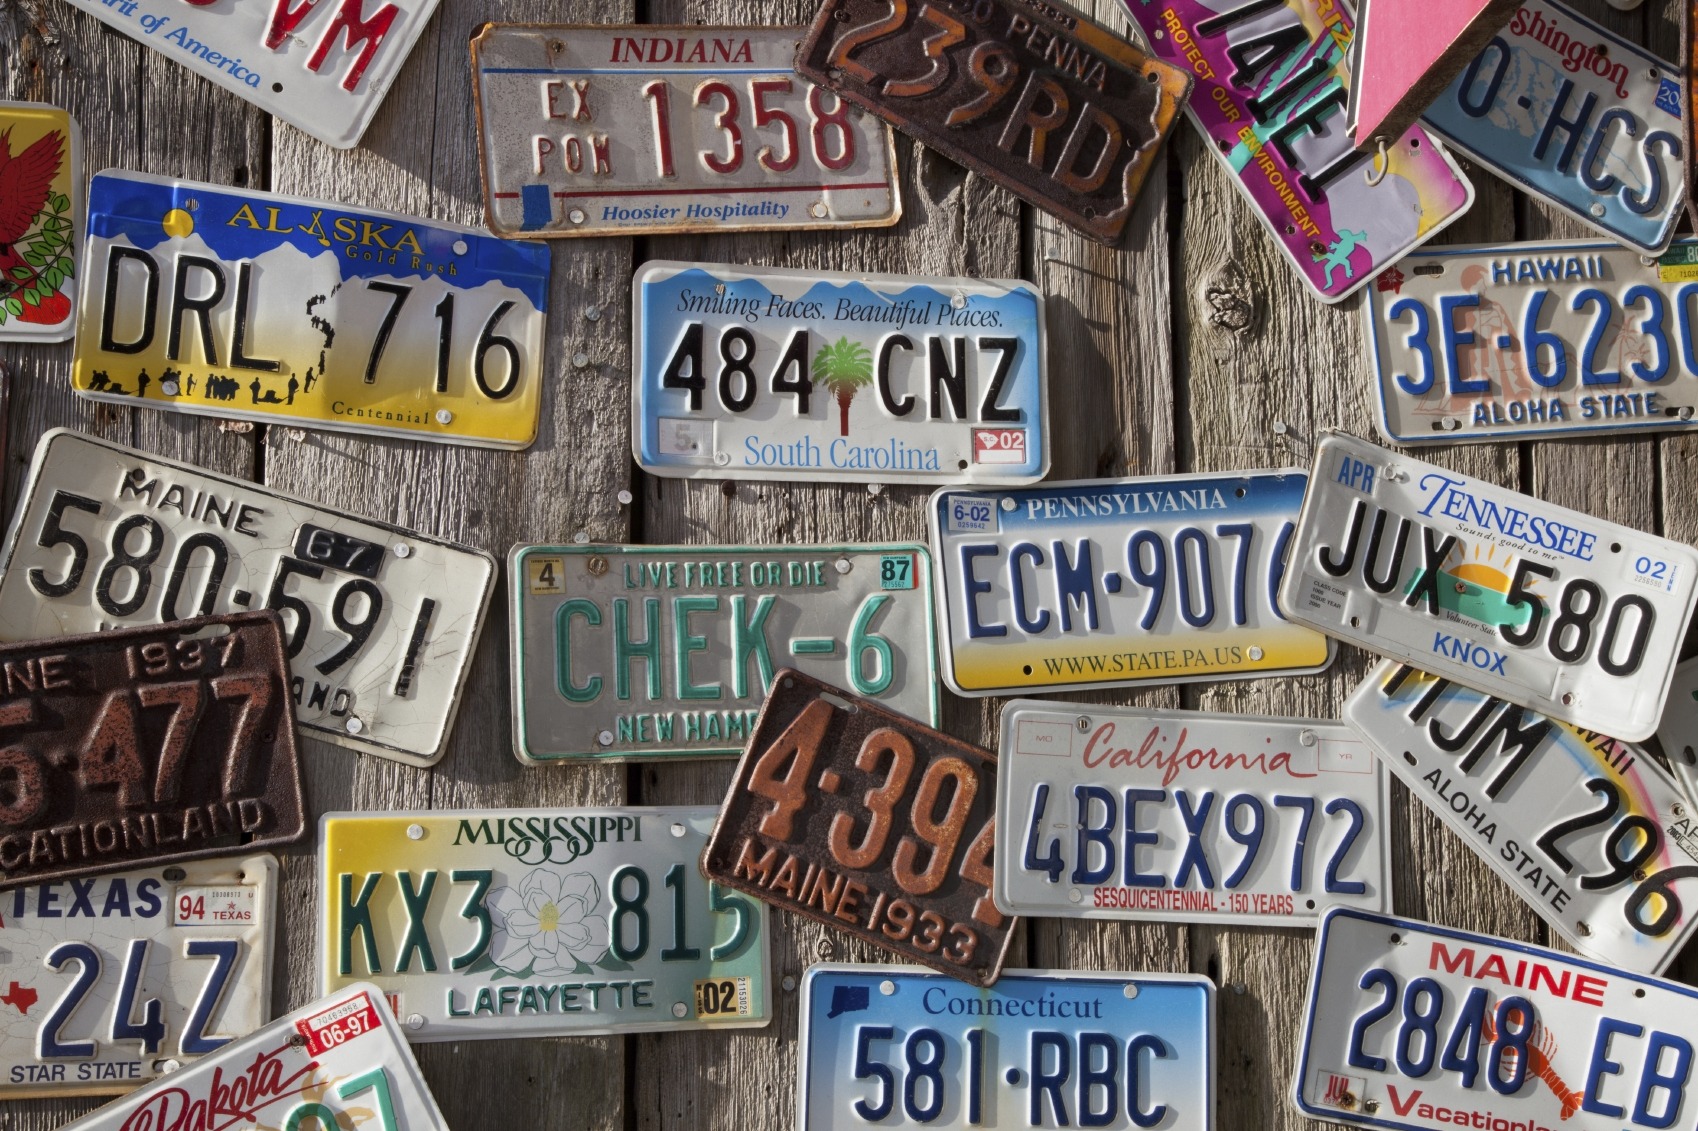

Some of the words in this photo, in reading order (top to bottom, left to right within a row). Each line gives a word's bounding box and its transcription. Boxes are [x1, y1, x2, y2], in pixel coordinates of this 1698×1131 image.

[140, 14, 171, 35] of
[164, 26, 262, 89] America
[610, 37, 754, 64] INDIANA
[1005, 13, 1106, 92] PENNA
[541, 80, 593, 121] EX
[642, 77, 855, 178] 1358
[1160, 8, 1215, 81] PROTECT
[1211, 86, 1240, 123] OUR
[1236, 126, 1320, 238] ENVIRONMENT
[602, 205, 681, 222] Hoosier
[685, 200, 790, 224] Hospitality
[346, 244, 398, 266] Gold
[410, 256, 459, 277] Rush
[1491, 255, 1604, 283] HAWAII
[100, 245, 281, 372] DRL
[363, 280, 521, 400] 716
[677, 288, 761, 322] Smiling
[765, 294, 826, 320] Faces.
[834, 297, 933, 331] Beautiful
[935, 300, 1003, 328] Places.
[662, 322, 814, 415] 484
[877, 333, 1022, 422] CNZ
[331, 401, 431, 426] Centennial
[1472, 397, 1565, 425] ALOHA
[1582, 392, 1660, 418] STATE
[744, 435, 823, 468] South
[829, 438, 942, 472] Carolina
[1000, 431, 1024, 450] 02
[1337, 456, 1376, 495] APR
[119, 469, 265, 537] MAINE
[953, 499, 992, 507] PENNSYLVANIA
[954, 504, 991, 522] 6-02
[1027, 488, 1228, 520] PENNSYLVANIA
[1417, 474, 1597, 562] TENNESSEE
[305, 528, 374, 569] 67
[1455, 522, 1497, 542] Sounds
[1497, 539, 1527, 551] good
[1527, 547, 1540, 555] to
[539, 562, 556, 587] 4
[625, 561, 678, 589] LIVE
[684, 561, 744, 588] FREE
[751, 561, 782, 588] OR
[787, 560, 827, 587] DIE
[881, 559, 910, 581] 87
[1635, 556, 1667, 580] 02
[1313, 580, 1332, 591] CLASS
[1331, 587, 1348, 597] CODE
[1318, 500, 1457, 617] JUX
[1498, 559, 1654, 678] 580
[1446, 610, 1479, 630] Volunteer
[126, 632, 244, 680] 1937
[1043, 646, 1243, 676] WWW.STATE.PA.US
[1433, 632, 1509, 677] KNOX
[618, 710, 675, 744] NEW
[1083, 722, 1318, 787] California
[1339, 752, 1353, 760] YR
[452, 815, 643, 865] MISSISSIPPI
[1024, 783, 1366, 895] 4BEX972
[1422, 767, 1498, 845] ALOHA
[1500, 838, 1572, 915] STATE
[1535, 777, 1698, 938] 296
[179, 894, 205, 921] 94
[212, 911, 252, 920] TEXAS
[339, 868, 494, 975] KX3
[610, 863, 751, 963] 815
[734, 838, 869, 924] MAINE
[867, 891, 979, 966] 1933
[1093, 887, 1218, 913] SESQUICENTENNIAL
[1228, 894, 1249, 914] 150
[1253, 894, 1294, 916] YEARS
[1428, 941, 1609, 1008] MAINE
[447, 980, 655, 1018] LAFAYETTE
[703, 980, 737, 1015] 02
[922, 986, 1104, 1020] Connecticut
[319, 1010, 370, 1049] 06-97
[1348, 967, 1536, 1096] 2848
[10, 1063, 66, 1084] STAR
[77, 1061, 143, 1081] STATE
[118, 1041, 326, 1131] Dakota
